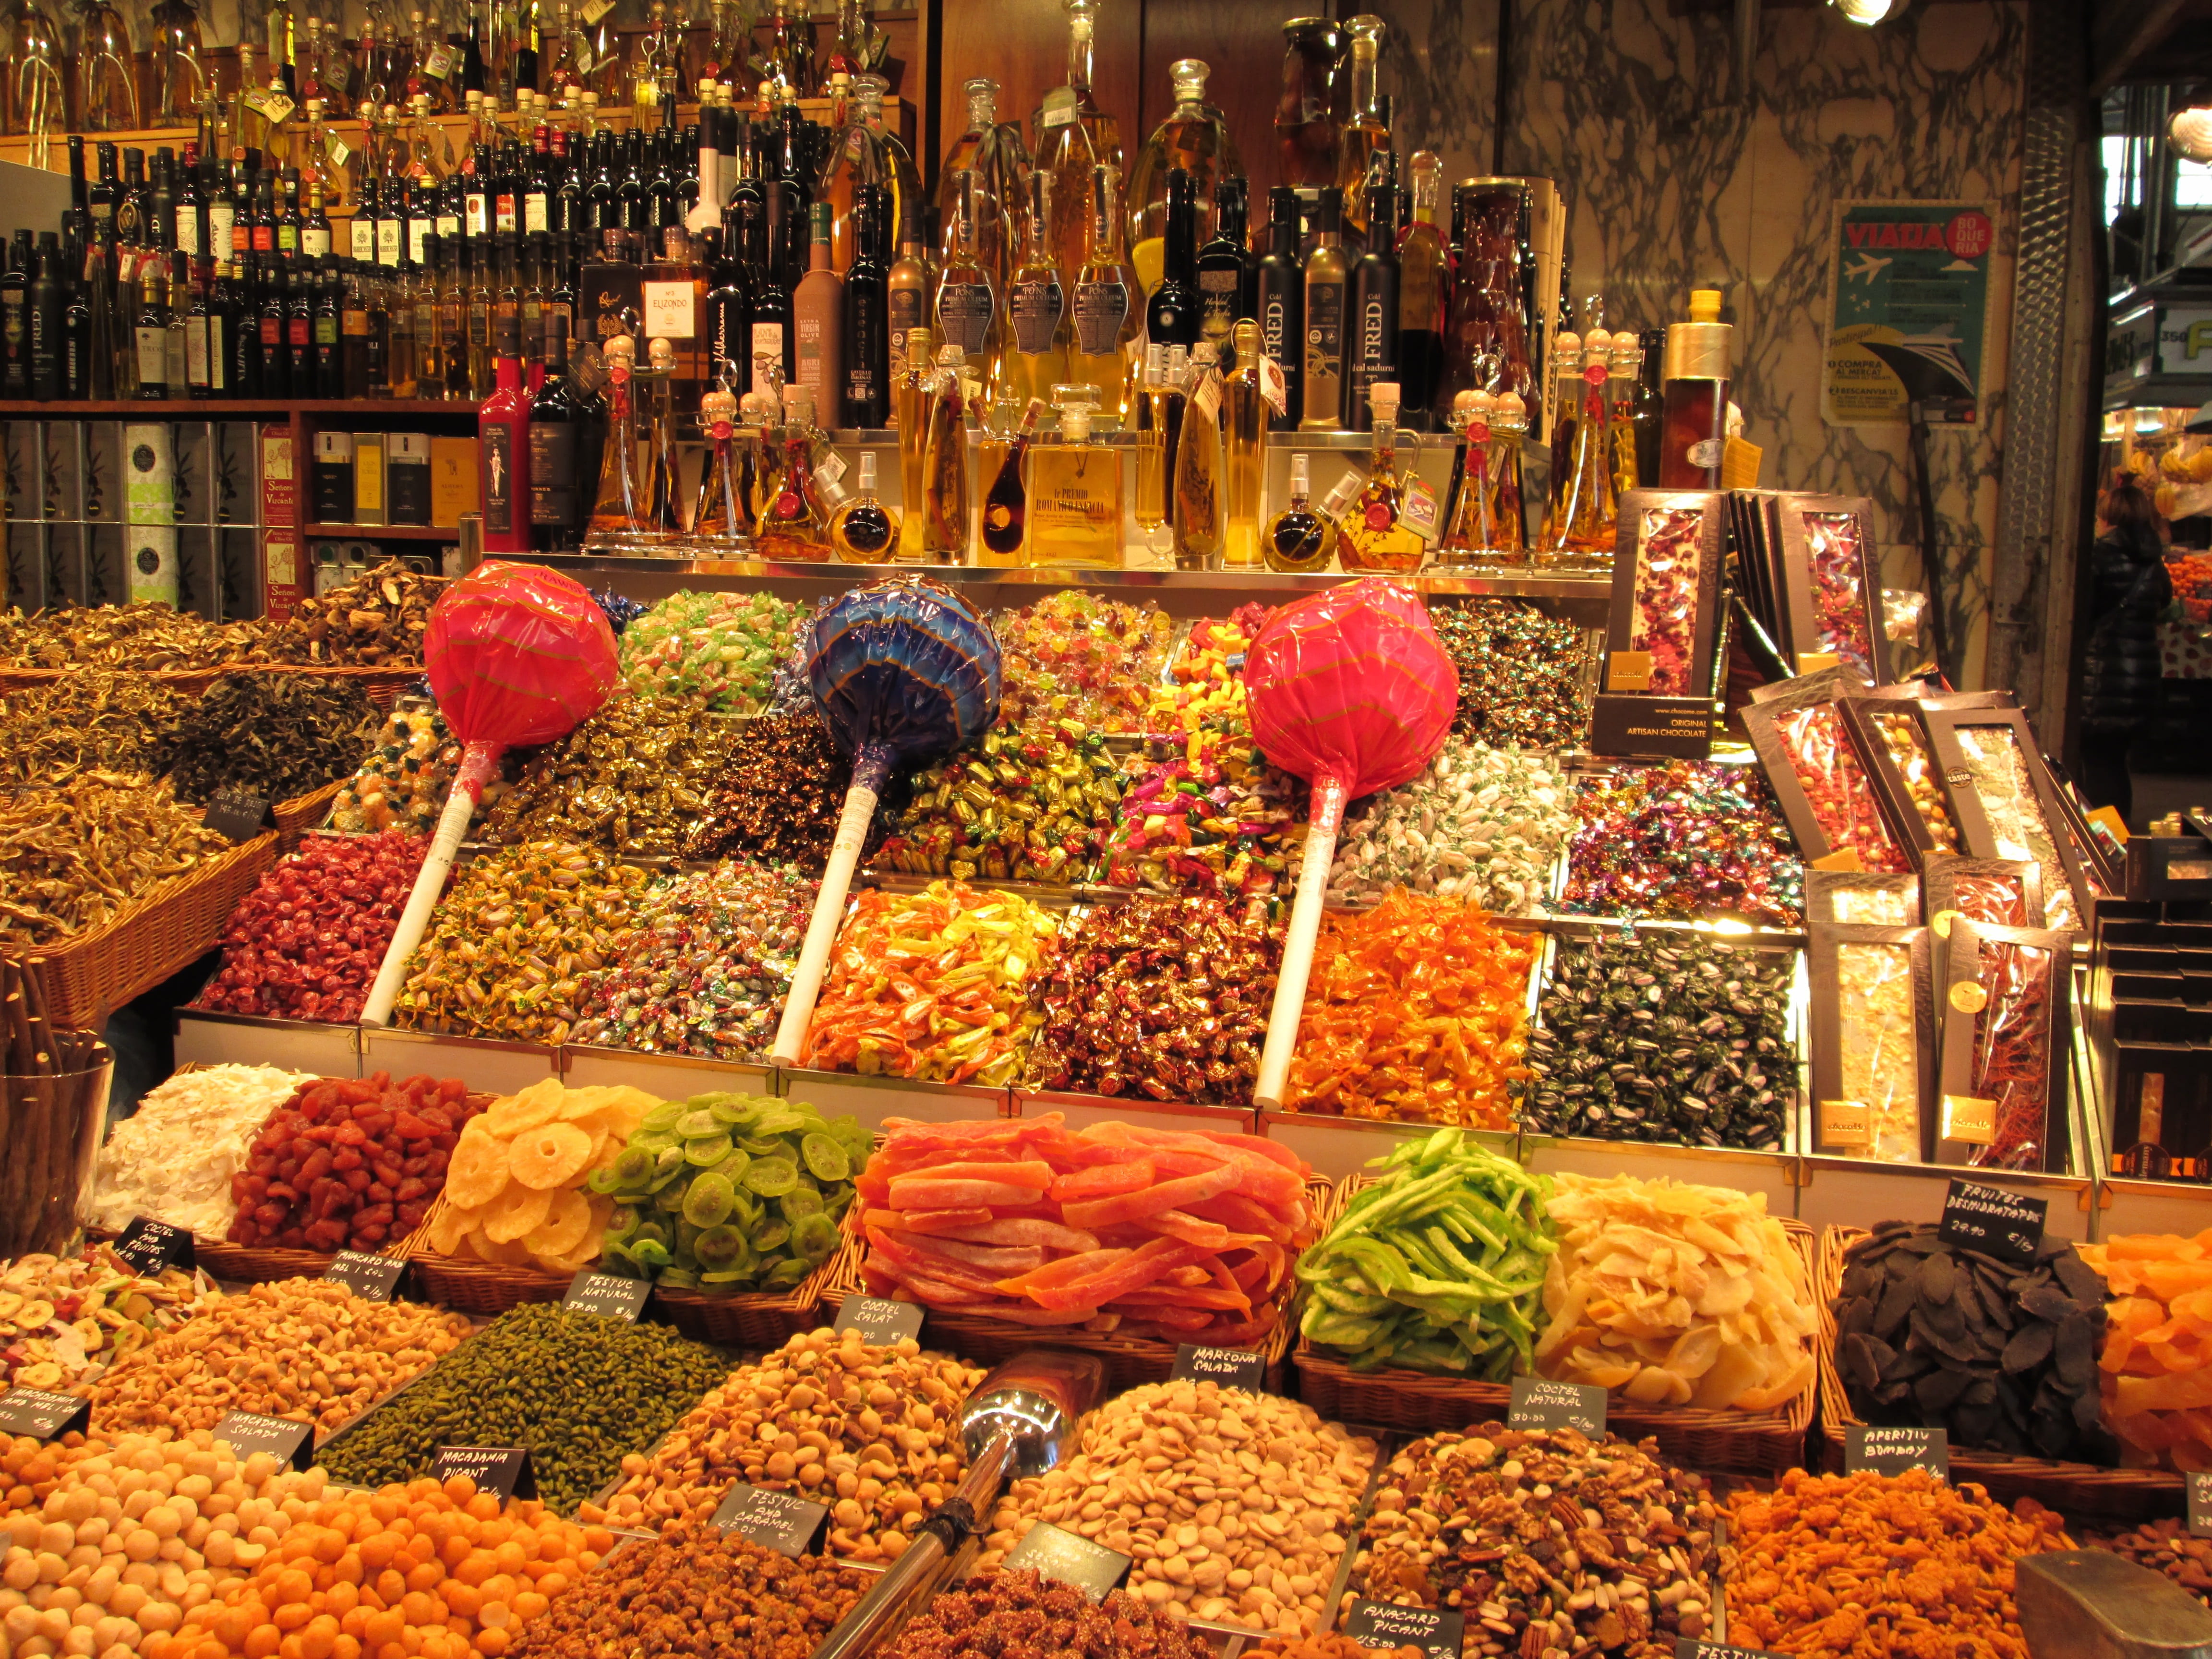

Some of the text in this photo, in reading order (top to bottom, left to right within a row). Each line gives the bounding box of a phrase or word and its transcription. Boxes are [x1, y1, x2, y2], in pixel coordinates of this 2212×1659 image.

[1957, 217, 1976, 229] BO
[1956, 229, 1985, 241] QUE
[1955, 241, 1979, 254] RIA
[955, 288, 974, 296] PONS
[653, 299, 687, 310] ELIZONDO
[33, 311, 43, 349] FRED
[800, 324, 820, 333] VIRGIN
[1267, 302, 1283, 359] FRED
[1365, 302, 1382, 360] FRED
[1838, 360, 1882, 368] COMPRA
[1062, 488, 1088, 500] PREMIO
[1671, 720, 1707, 728] ORIGINAL
[1627, 728, 1707, 738] ARTISAN CHOCOLATE
[1948, 772, 1972, 782] taste
[144, 1223, 174, 1237] COCTEL
[139, 1233, 159, 1243] AMB
[125, 1239, 166, 1254] FRUITES
[337, 1251, 382, 1265] ANACARD
[331, 1263, 350, 1272] MEL
[365, 1268, 384, 1277] SAL
[586, 1275, 633, 1289] FESTUC
[581, 1287, 635, 1300] NATURAL
[860, 1300, 900, 1315] COCTEL
[854, 1311, 894, 1323] SALAT
[1192, 1348, 1257, 1364] MARCONA
[1193, 1360, 1239, 1373] SALADA
[11, 1388, 78, 1405] MACADAMIA
[1536, 1383, 1581, 1397] COCTEL
[0, 1397, 27, 1407] AMB
[30, 1401, 55, 1411] MEL
[1525, 1394, 1582, 1407] NATURAL
[228, 1413, 300, 1432] MACADAMIA
[1511, 1413, 1545, 1422] 30.00
[230, 1424, 279, 1439] SALADA
[438, 1451, 508, 1465] MACADAMIA
[1865, 1445, 1928, 1458] BOMBAY
[441, 1467, 489, 1481] PICANT
[747, 1490, 805, 1510] FESTUC
[734, 1511, 795, 1531] CARAMEL
[1363, 1606, 1441, 1625] ANACARD
[1373, 1620, 1435, 1637] PICANT
